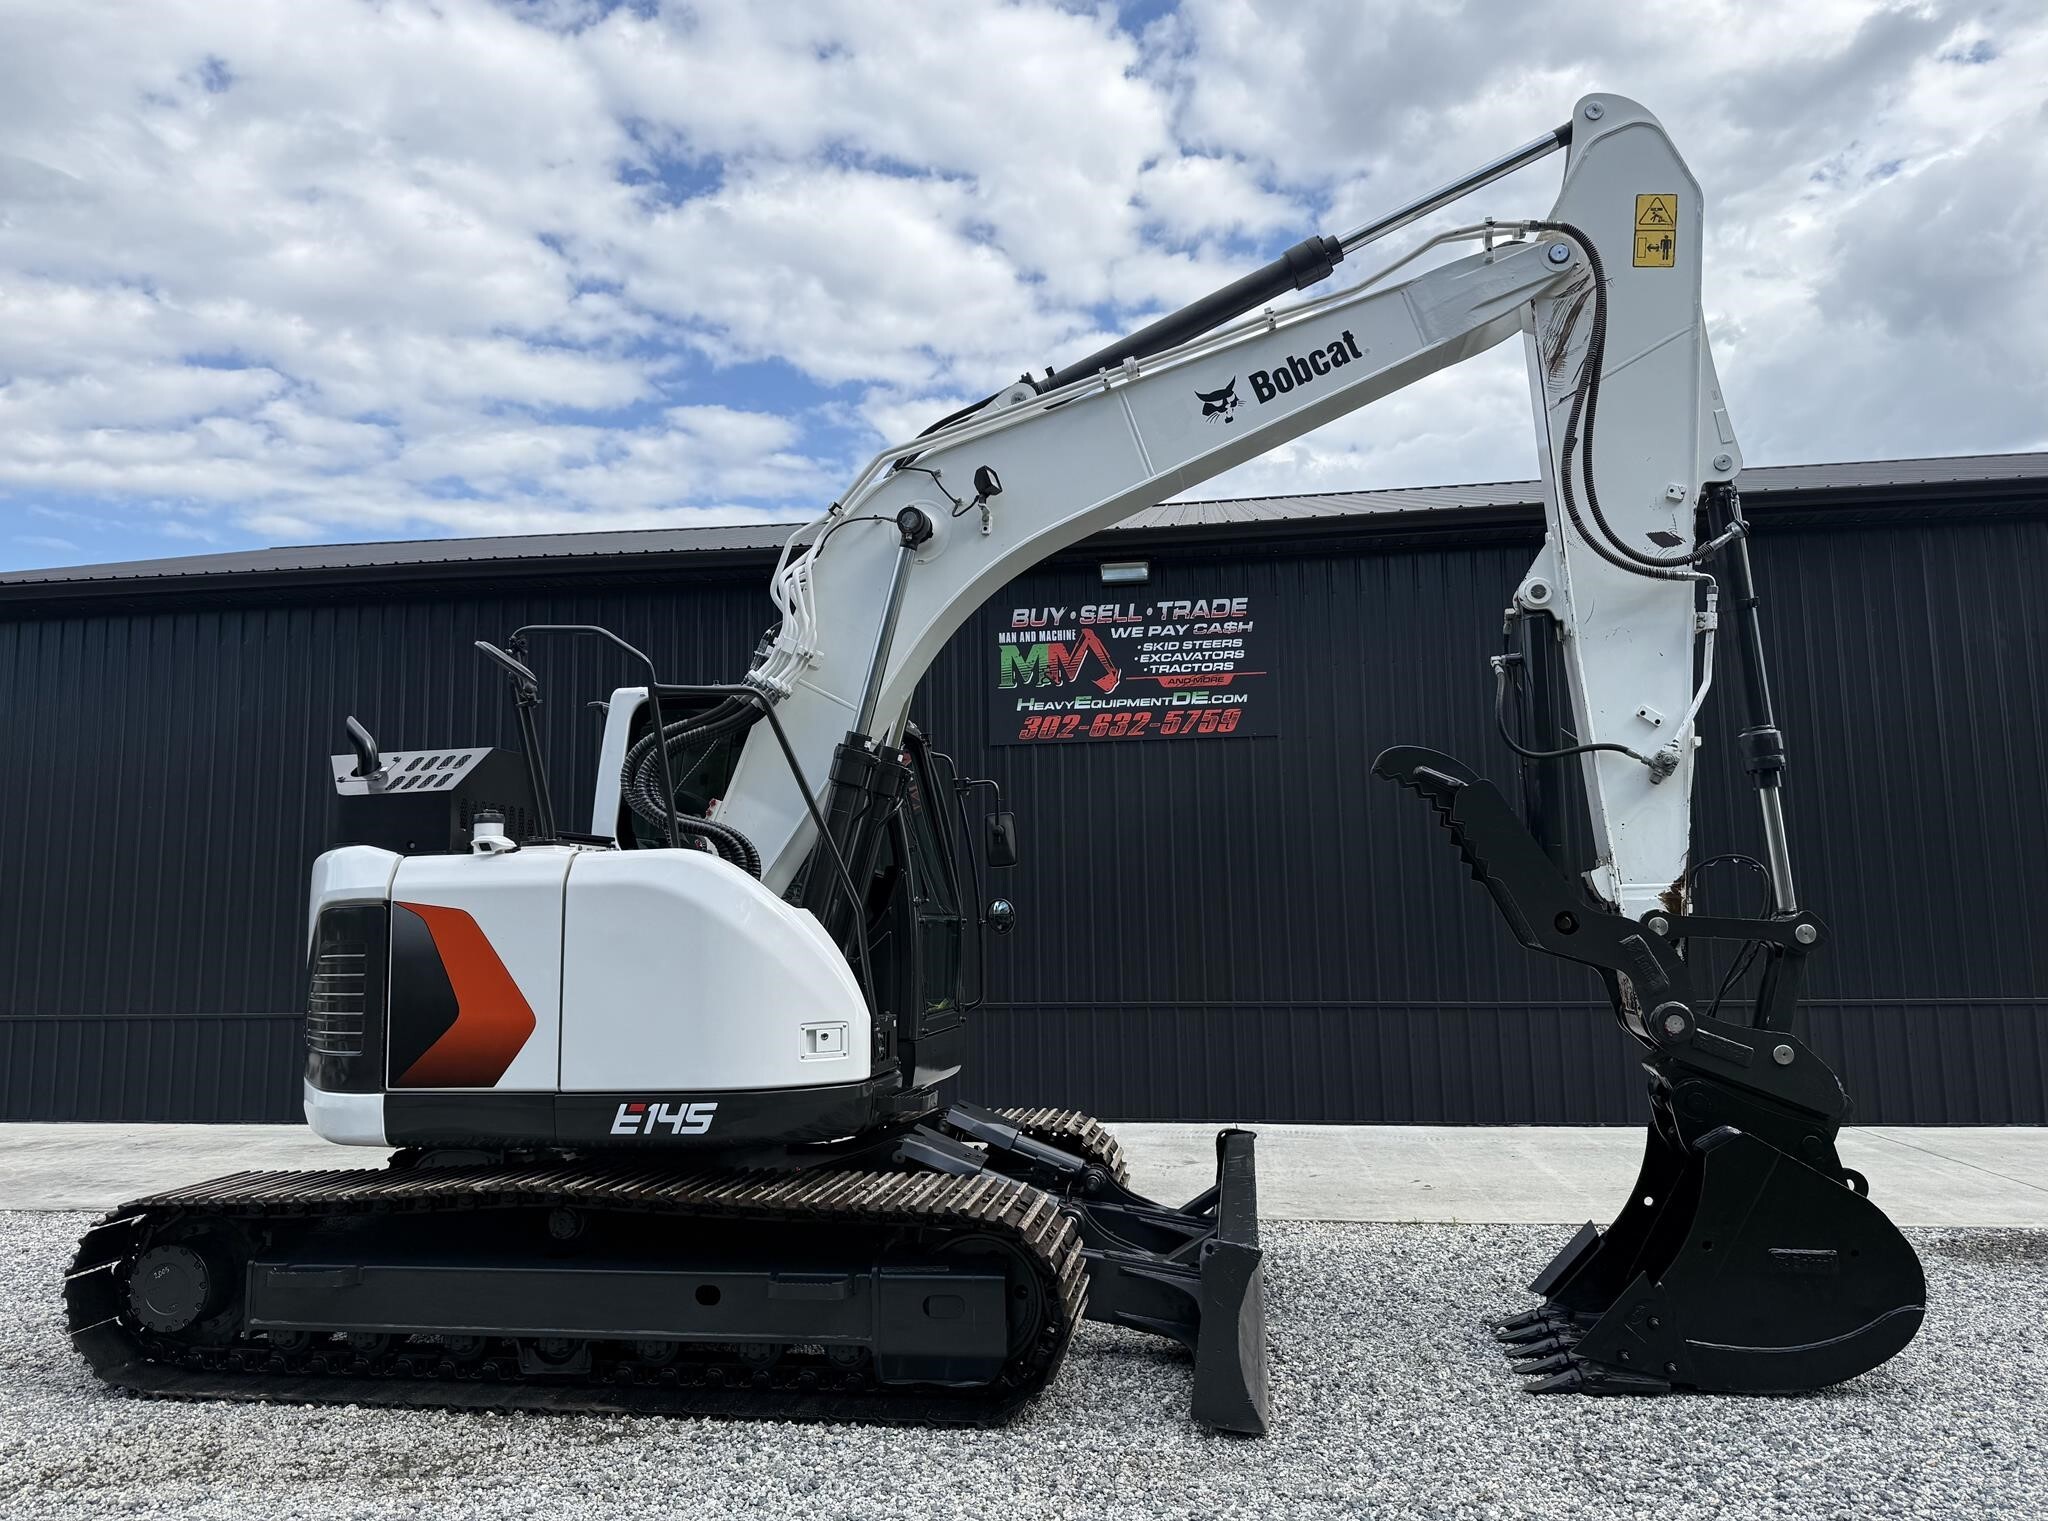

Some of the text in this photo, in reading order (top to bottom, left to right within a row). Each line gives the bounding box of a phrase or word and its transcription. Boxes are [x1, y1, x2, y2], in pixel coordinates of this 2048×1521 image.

[1248, 330, 1363, 405] Bobcat
[1012, 597, 1249, 628] BUY SELL TRADE
[999, 629, 1077, 643] MAN AND MACHINE
[1111, 621, 1254, 639] WE PAY CA$H
[1142, 638, 1243, 652] SKID STEERS
[1139, 650, 1245, 663] EXCAVATORS
[1149, 661, 1235, 674] TRACTORS
[1019, 708, 1242, 739] 302-632-5759
[610, 1102, 719, 1135] E145
